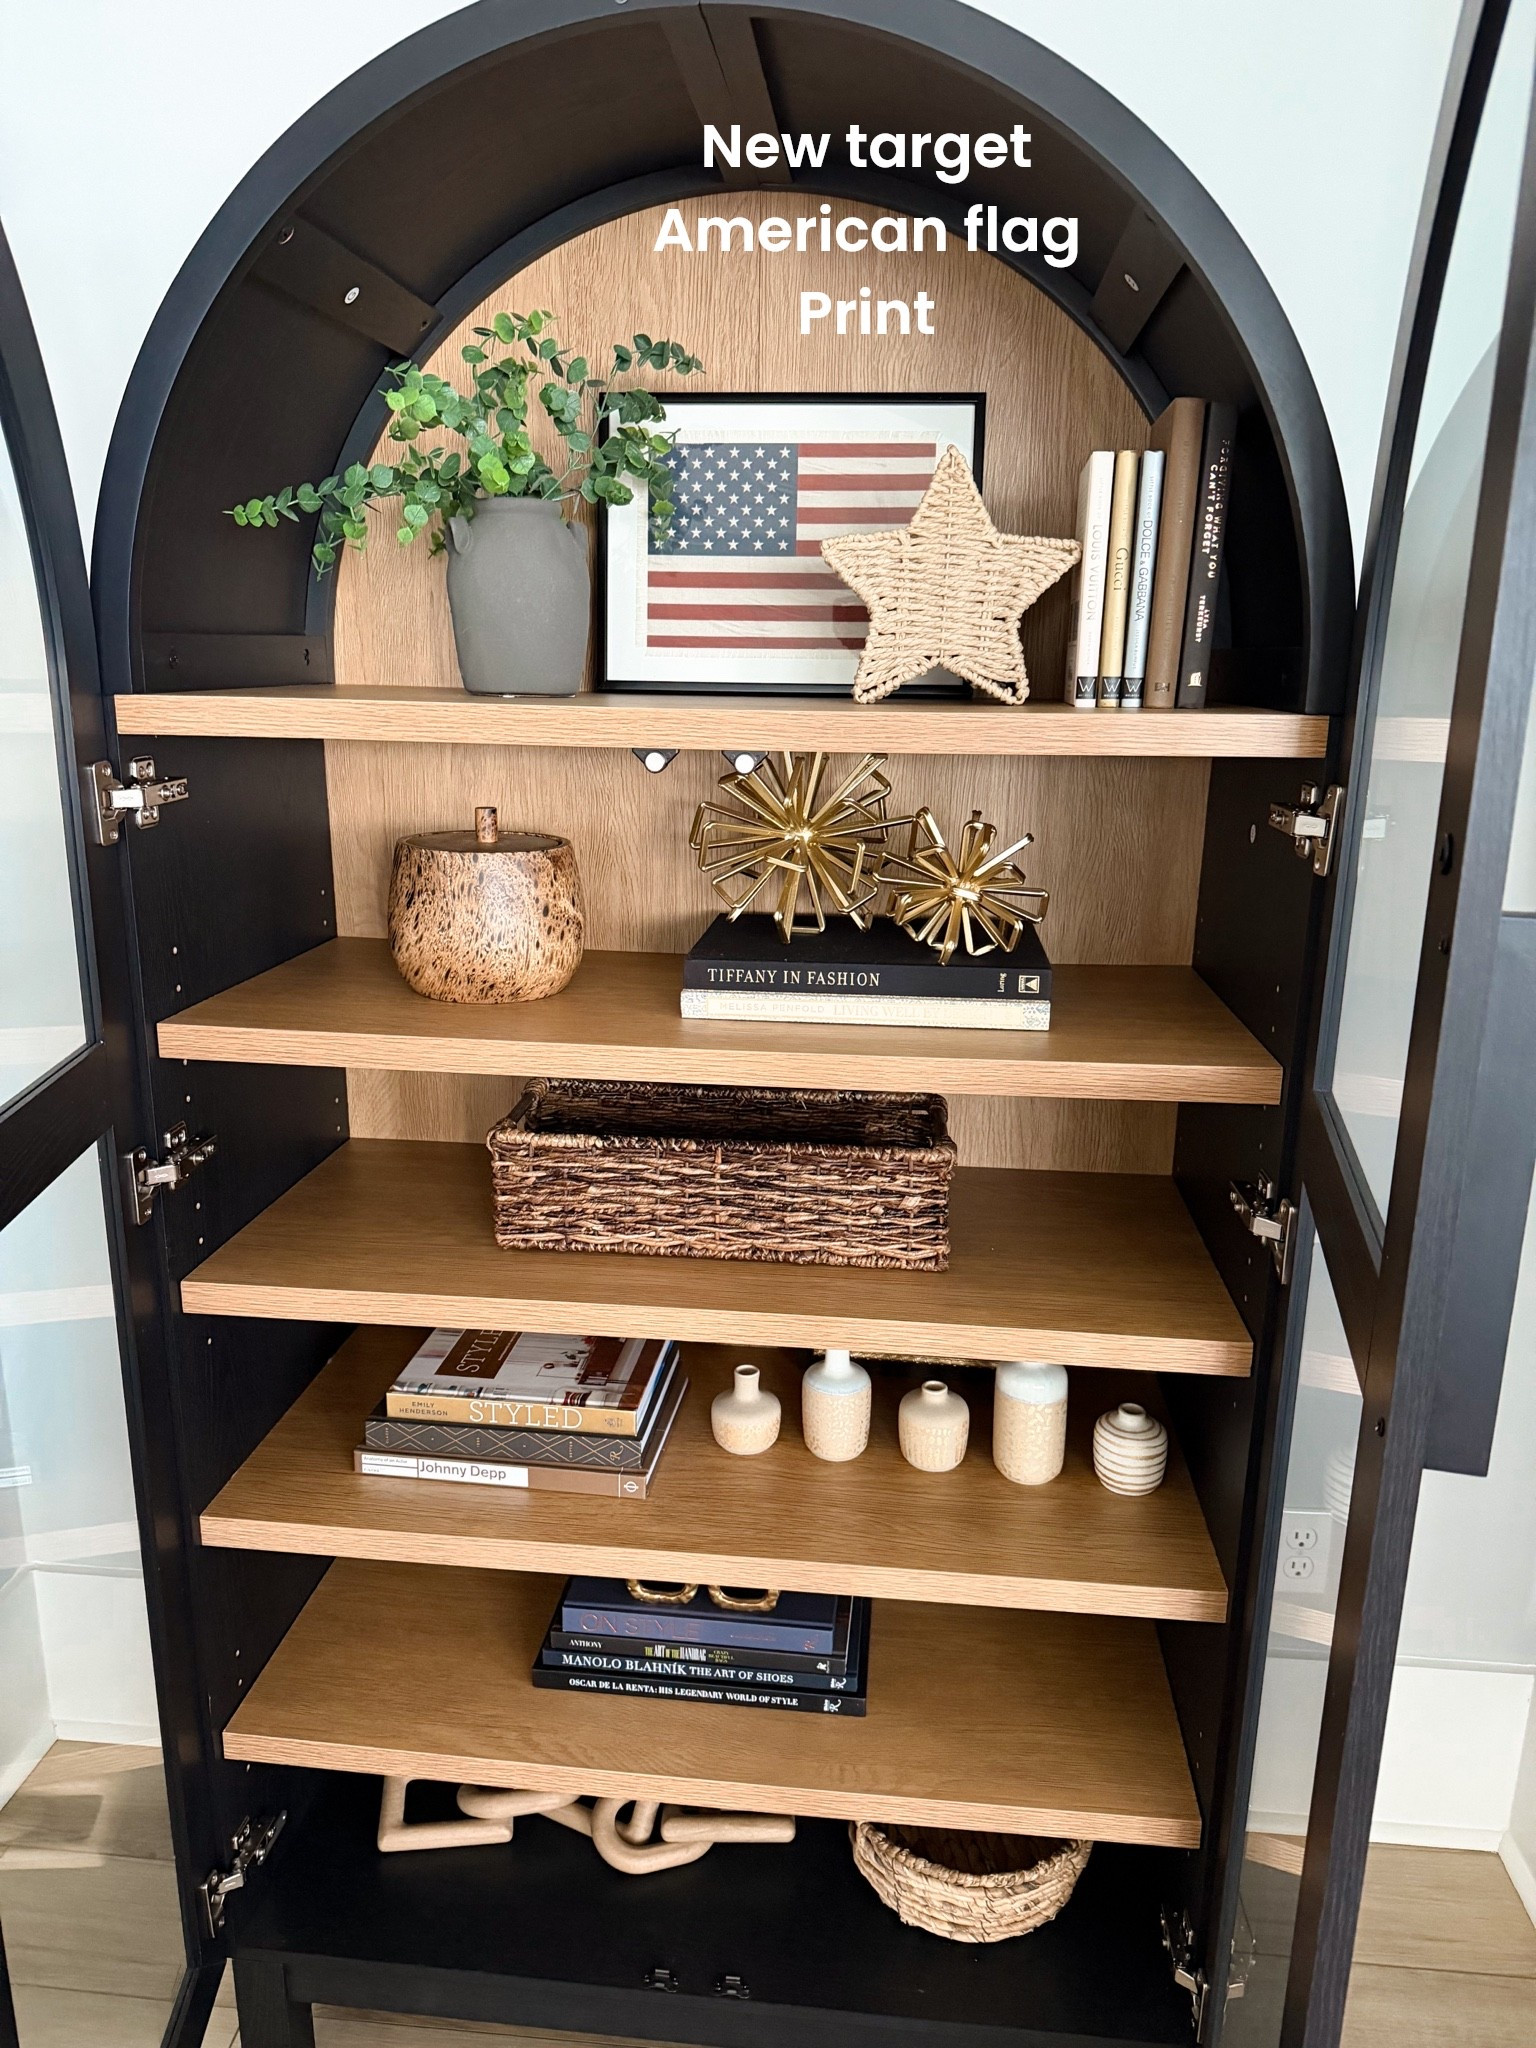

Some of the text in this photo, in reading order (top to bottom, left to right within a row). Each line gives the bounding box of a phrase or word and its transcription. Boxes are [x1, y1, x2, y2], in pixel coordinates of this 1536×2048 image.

[1201, 464, 1218, 555] CAN'T FORGET
[1207, 439, 1230, 579] FORGIVING WHAT YOU
[1091, 523, 1103, 563] LOUIS
[1140, 520, 1153, 559] DOLCE
[1113, 547, 1129, 592] Gucci
[1086, 566, 1101, 623] VUITTON
[1134, 567, 1149, 622] GABBANA
[1202, 608, 1211, 630] LYSA
[707, 967, 880, 988] TIFFANY IN FASHION
[720, 1002, 766, 1011] MELISSA
[772, 1004, 825, 1013] PENFOLD
[833, 1005, 878, 1017] LIVING
[883, 1006, 917, 1017] WELL
[399, 1407, 448, 1416] HENDERSON
[411, 1401, 435, 1409] EMILY
[468, 1400, 583, 1429] STYLED
[420, 1461, 507, 1481] Johnny Depp
[580, 1613, 700, 1640] ON STYLE
[568, 1638, 603, 1649] ANTHONY
[653, 1645, 665, 1659] ART
[562, 1654, 794, 1684] MANOLO BLAHNÍK THE ART OF SHOES
[568, 1678, 798, 1706] OSCAR DE LA RENTA: HIS LEGENDARY WORLD OF STYLE
